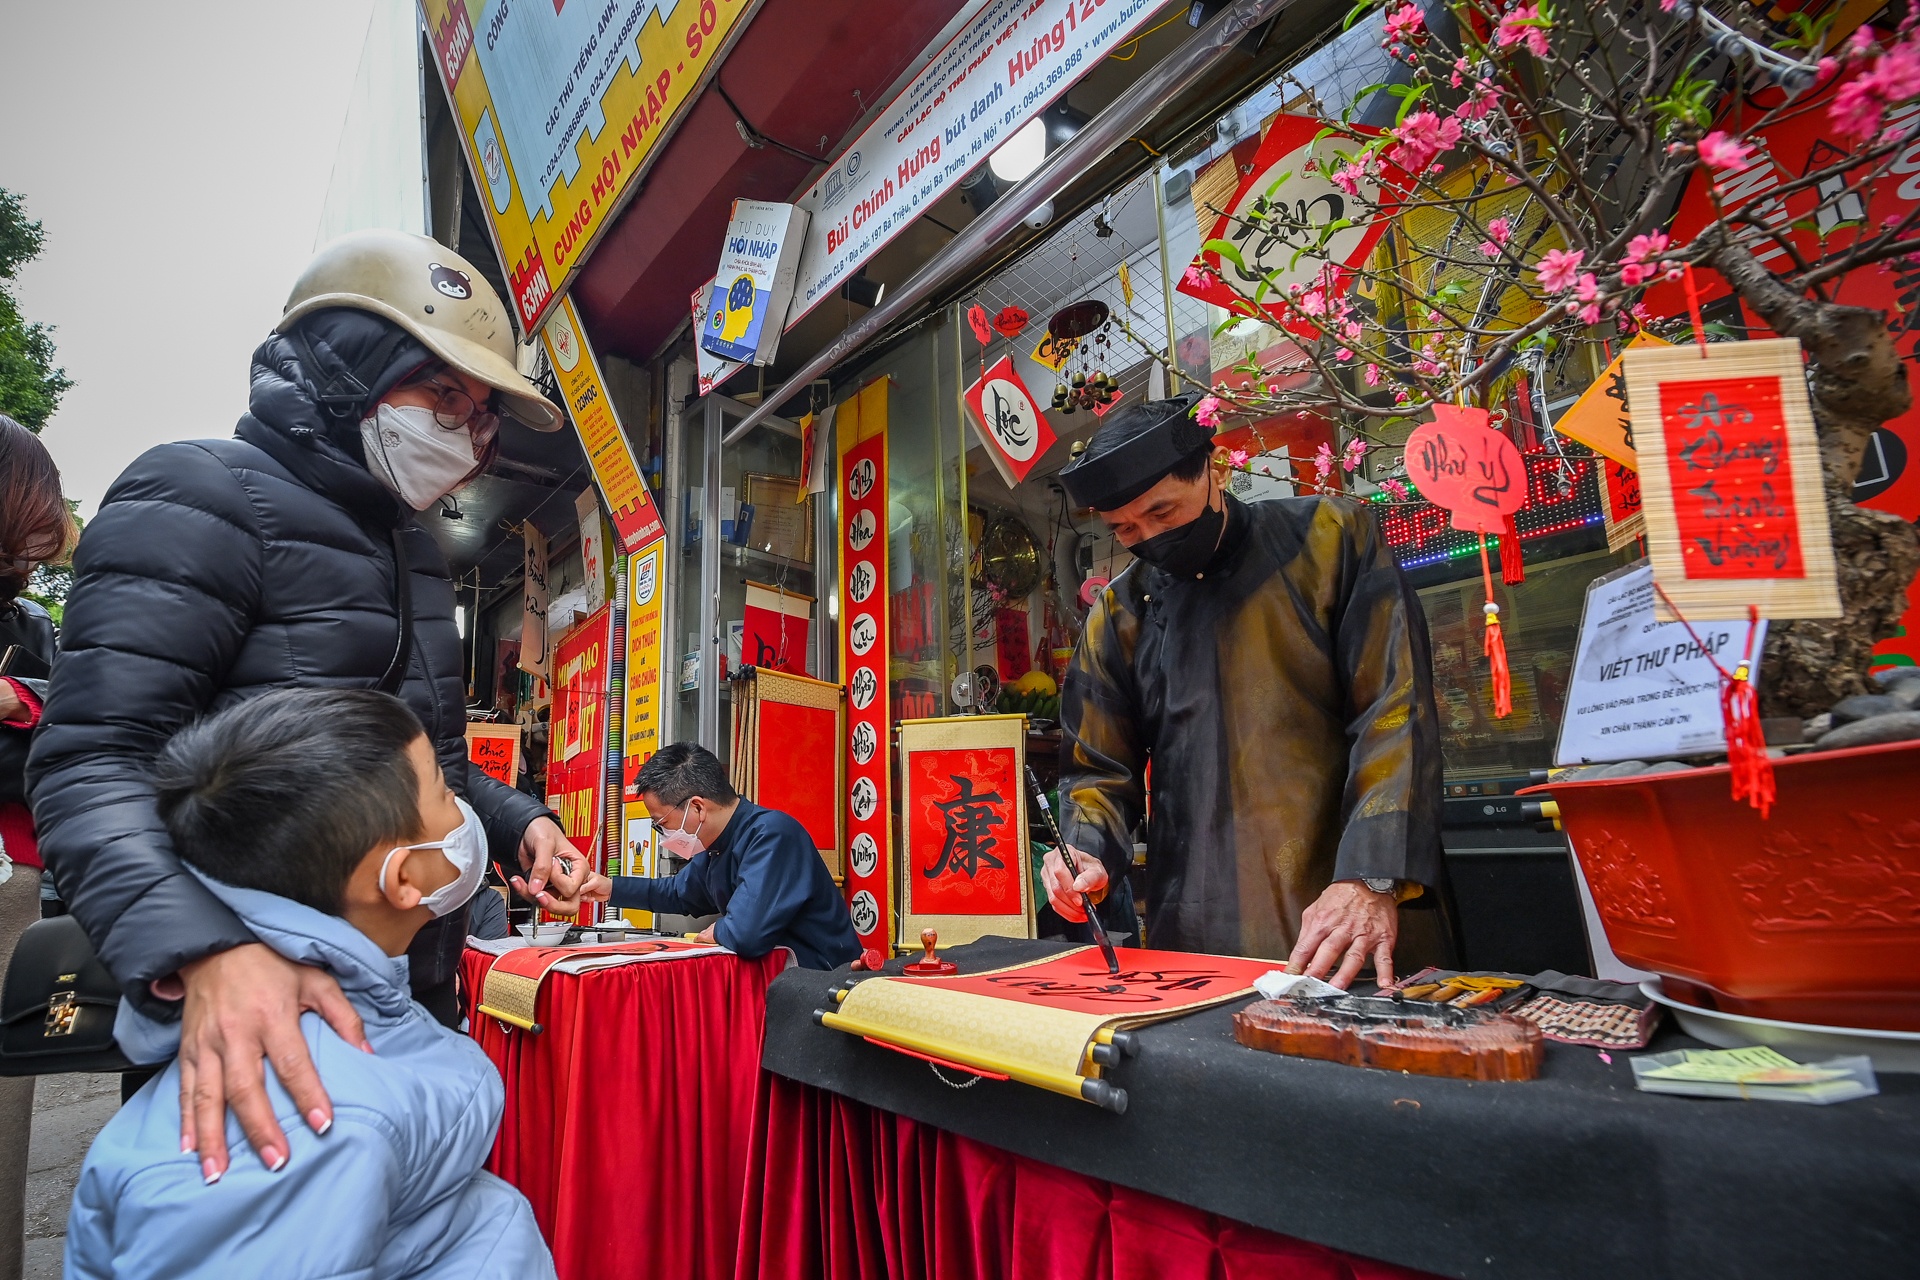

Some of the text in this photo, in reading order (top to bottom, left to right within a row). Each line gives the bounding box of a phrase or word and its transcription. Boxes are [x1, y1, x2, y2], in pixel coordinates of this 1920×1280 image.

[445, 12, 470, 80] 63HN
[883, 116, 905, 139] TRUNG
[905, 100, 919, 118] TÂM
[919, 73, 948, 103] UNESCO
[947, 53, 967, 77] PHÁT
[967, 29, 991, 56] TRIỂN
[992, 11, 1009, 31] VĂN
[926, 62, 942, 81] HIỆP
[943, 47, 958, 65] CÁC
[958, 33, 972, 49] HỘI
[972, 0, 1004, 35] UNESCO
[545, 103, 560, 136] CÁC
[558, 75, 574, 110] THỨ
[573, 34, 598, 80] TIẾNG
[897, 121, 915, 144] CÂU
[915, 105, 932, 127] LẠC
[933, 90, 946, 109] BỘ
[947, 72, 967, 93] THƯ
[967, 44, 994, 74] PHÁP
[995, 18, 1019, 46] VIỆT
[826, 216, 849, 256] Bùi
[852, 174, 895, 230] Chính
[897, 135, 942, 190] Hưng
[945, 114, 967, 146] bút
[970, 82, 1003, 123] danh
[1008, 0, 1107, 87] Hưng12
[833, 259, 845, 280] CLB
[871, 225, 882, 244] 197
[883, 217, 892, 234] Bà
[912, 194, 920, 207] Q.
[920, 180, 933, 200] Hai
[933, 171, 943, 189] Bà
[944, 155, 966, 181] Trưng
[971, 137, 982, 156] Hà
[983, 126, 997, 145] Nội
[1023, 48, 1083, 109] 0943.369.888
[553, 199, 592, 267] CUNG
[590, 154, 622, 208] HỘI
[620, 69, 671, 152] NHẬP
[728, 235, 778, 261] HỘI NHẬP
[739, 221, 777, 237] TƯ DUY
[521, 266, 549, 322] 63HN
[574, 384, 598, 414] 123HỌC
[1599, 632, 1730, 682] VIẾT THƯ PHÁP
[1577, 707, 1587, 716] VUI
[1587, 703, 1605, 715] LÒNG
[1637, 691, 1661, 704] TRONG
[1600, 727, 1611, 736] XIN
[1612, 722, 1632, 734] CHÂN
[1632, 718, 1658, 730] THÀNH
[924, 775, 1005, 880] 康
